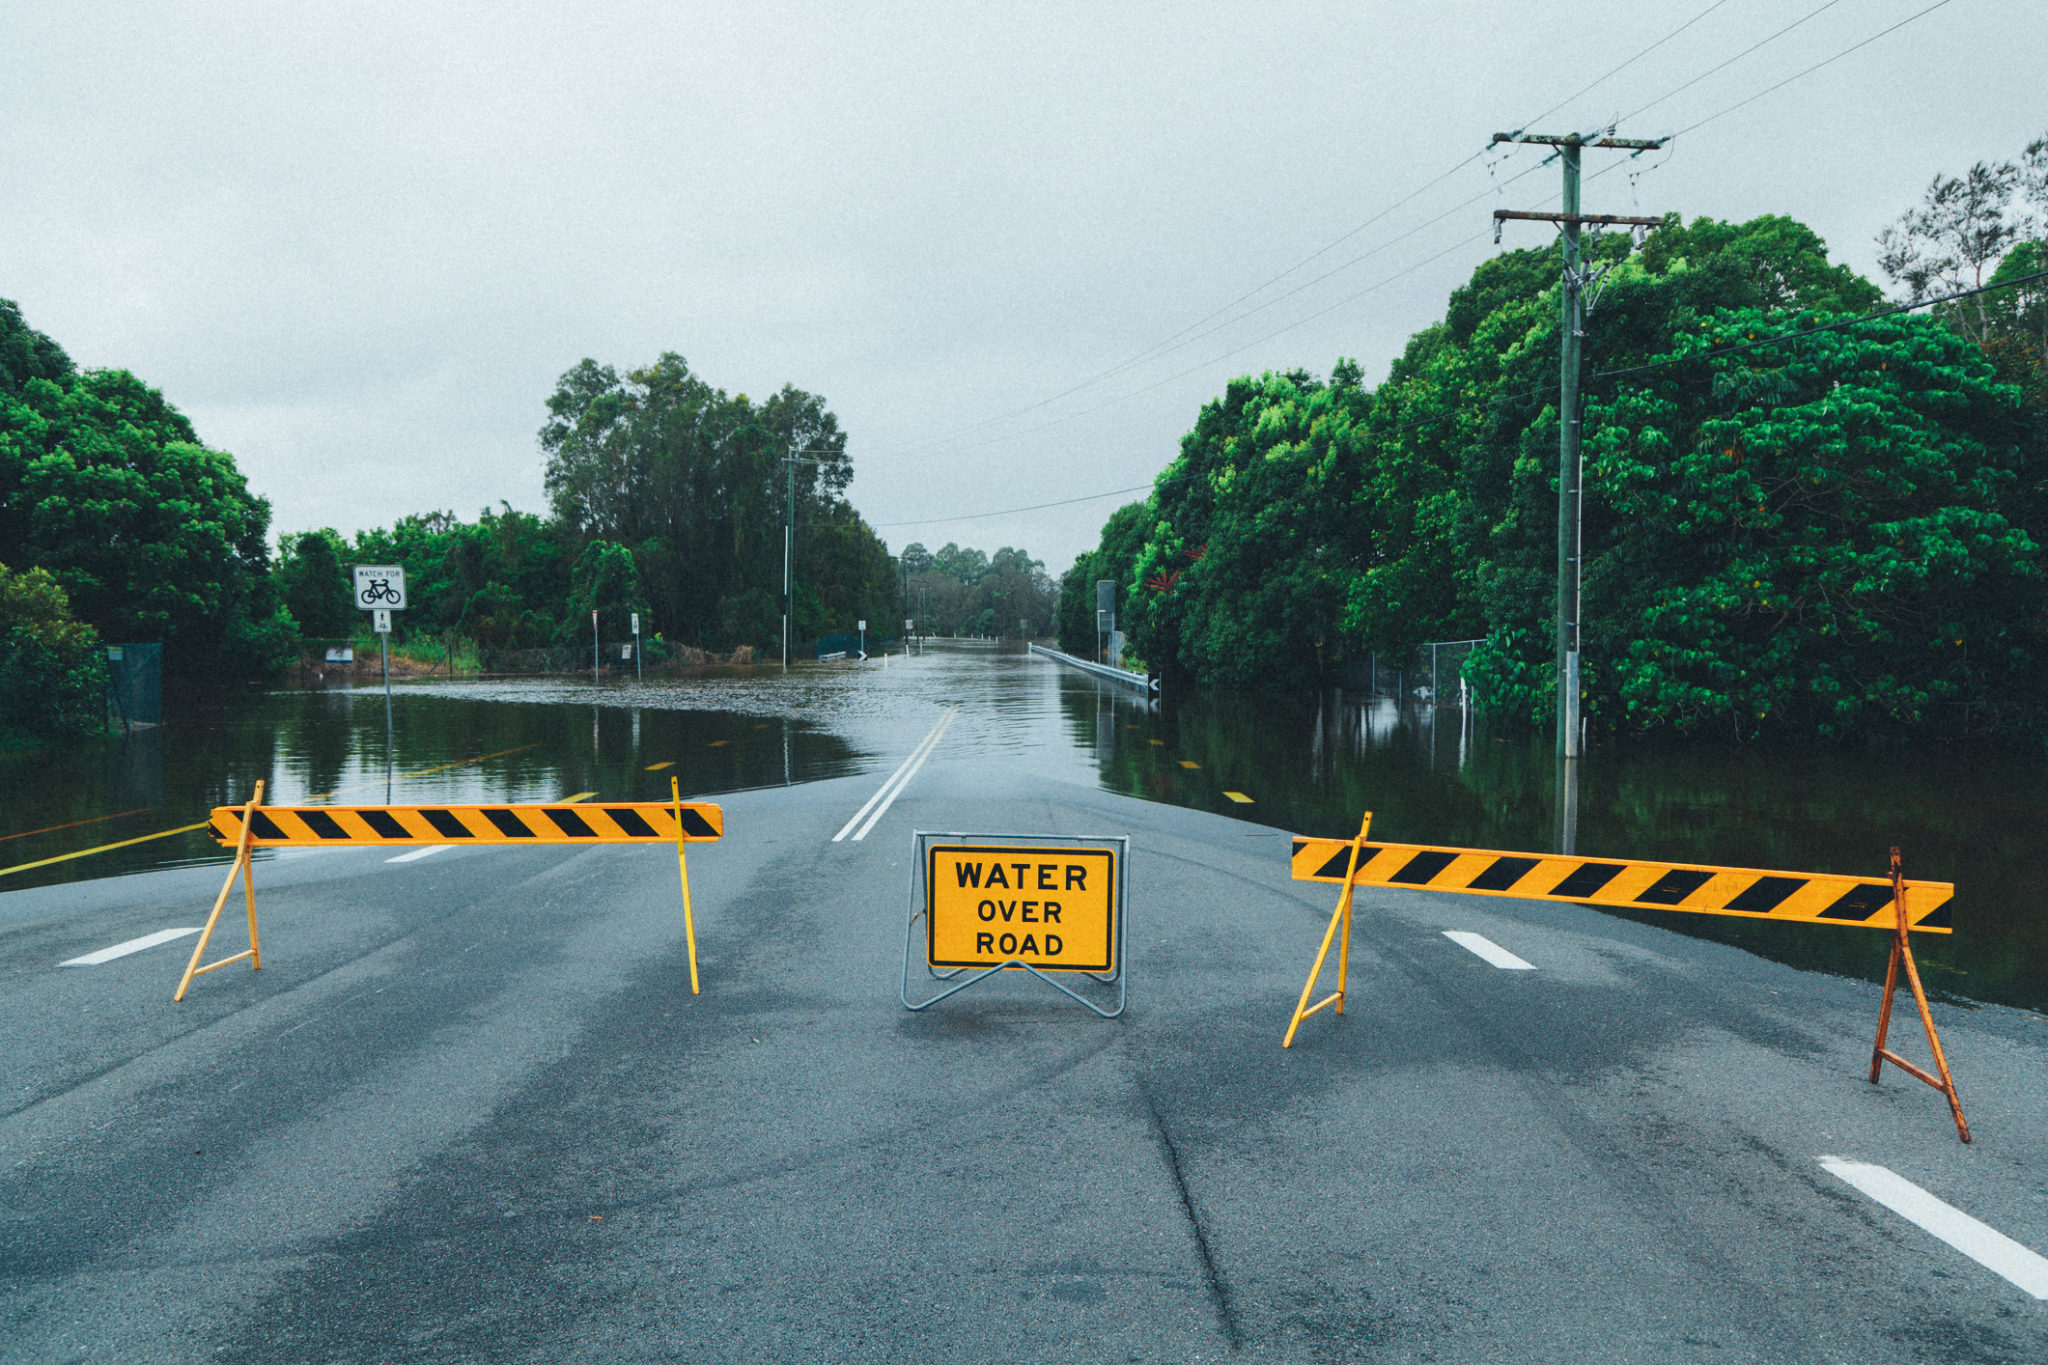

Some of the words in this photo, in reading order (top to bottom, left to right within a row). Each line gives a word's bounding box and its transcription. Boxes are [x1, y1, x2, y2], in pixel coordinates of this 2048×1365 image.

[956, 862, 1087, 891] WATER
[978, 899, 1061, 923] OVER
[977, 932, 1063, 956] ROAD
